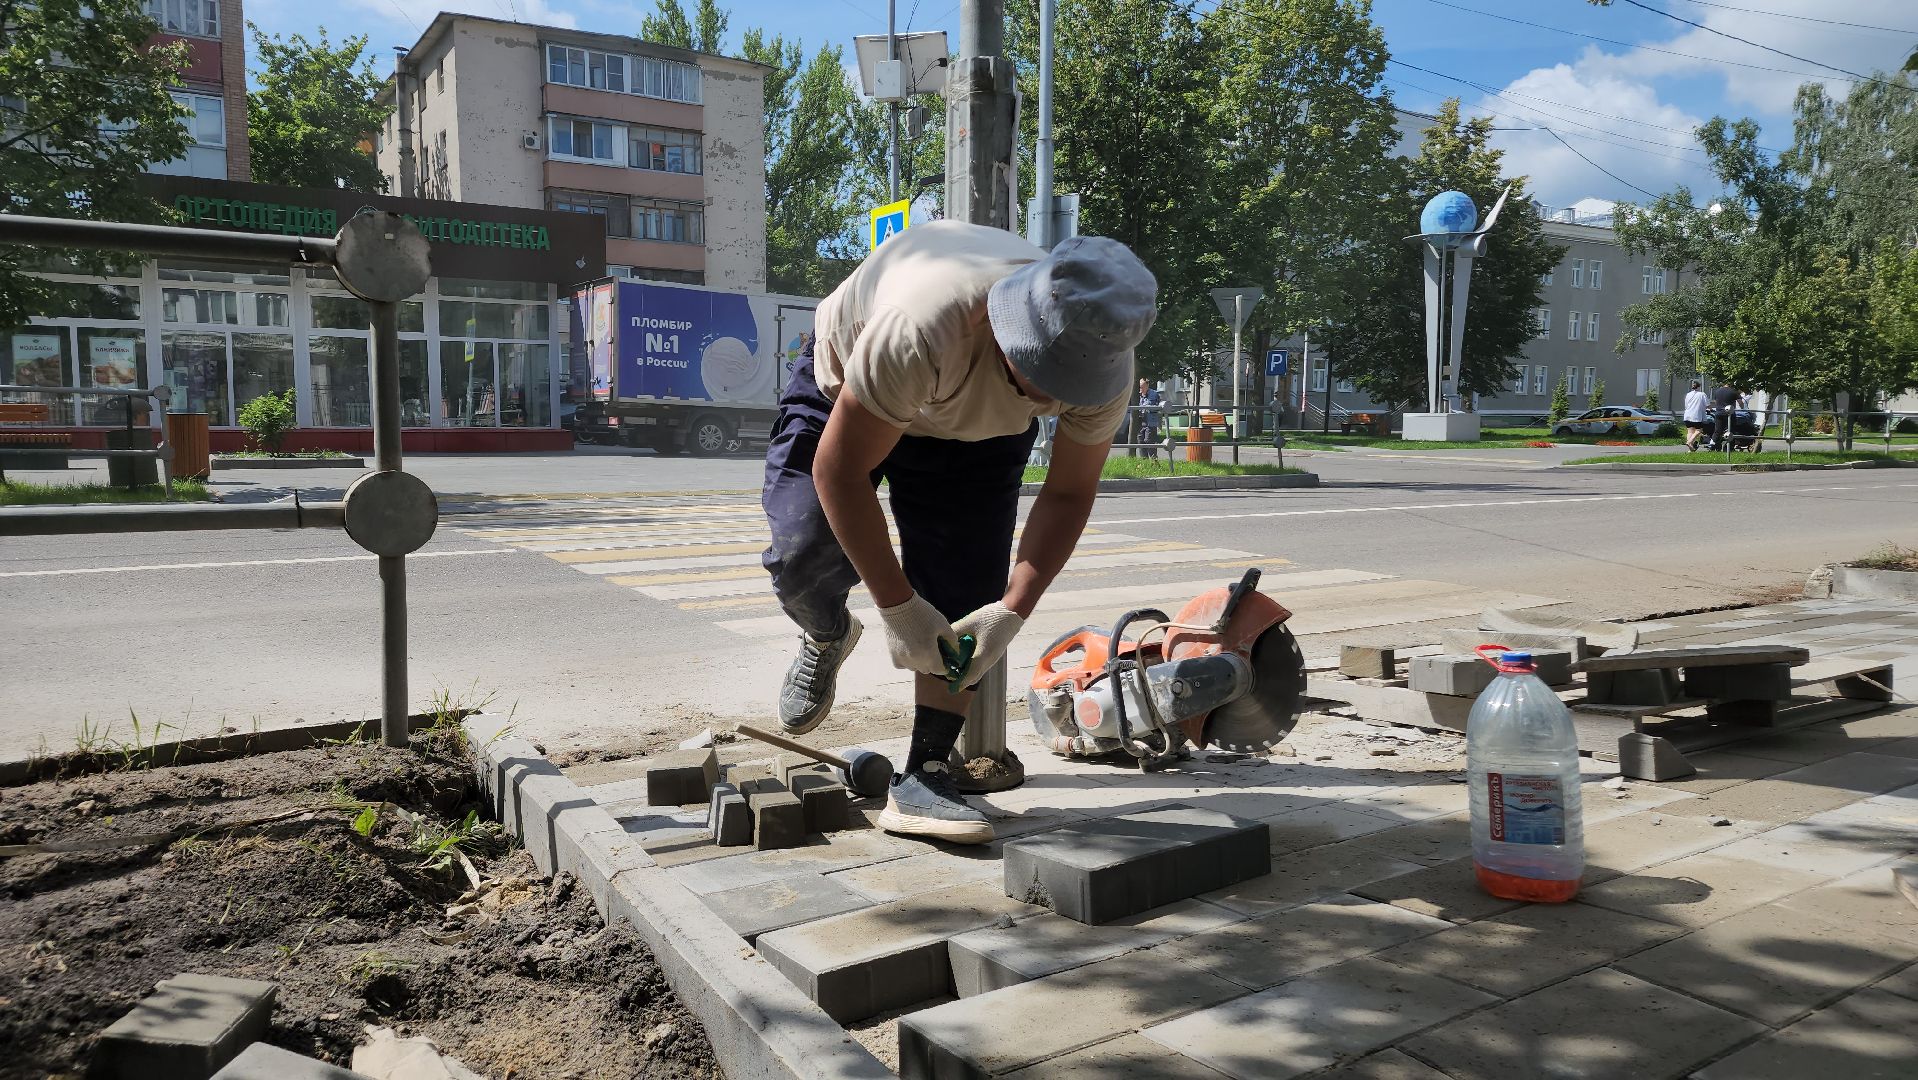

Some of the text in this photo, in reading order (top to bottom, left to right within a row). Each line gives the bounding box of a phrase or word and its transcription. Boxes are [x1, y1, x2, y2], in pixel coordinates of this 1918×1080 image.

[175, 194, 337, 236] ОРТОПЕДИЯ
[631, 316, 692, 331] ПЛОМБИР
[645, 332, 679, 354] №1
[636, 357, 644, 366] в
[1270, 353, 1283, 372] P
[1491, 776, 1503, 838] Семерикъ
